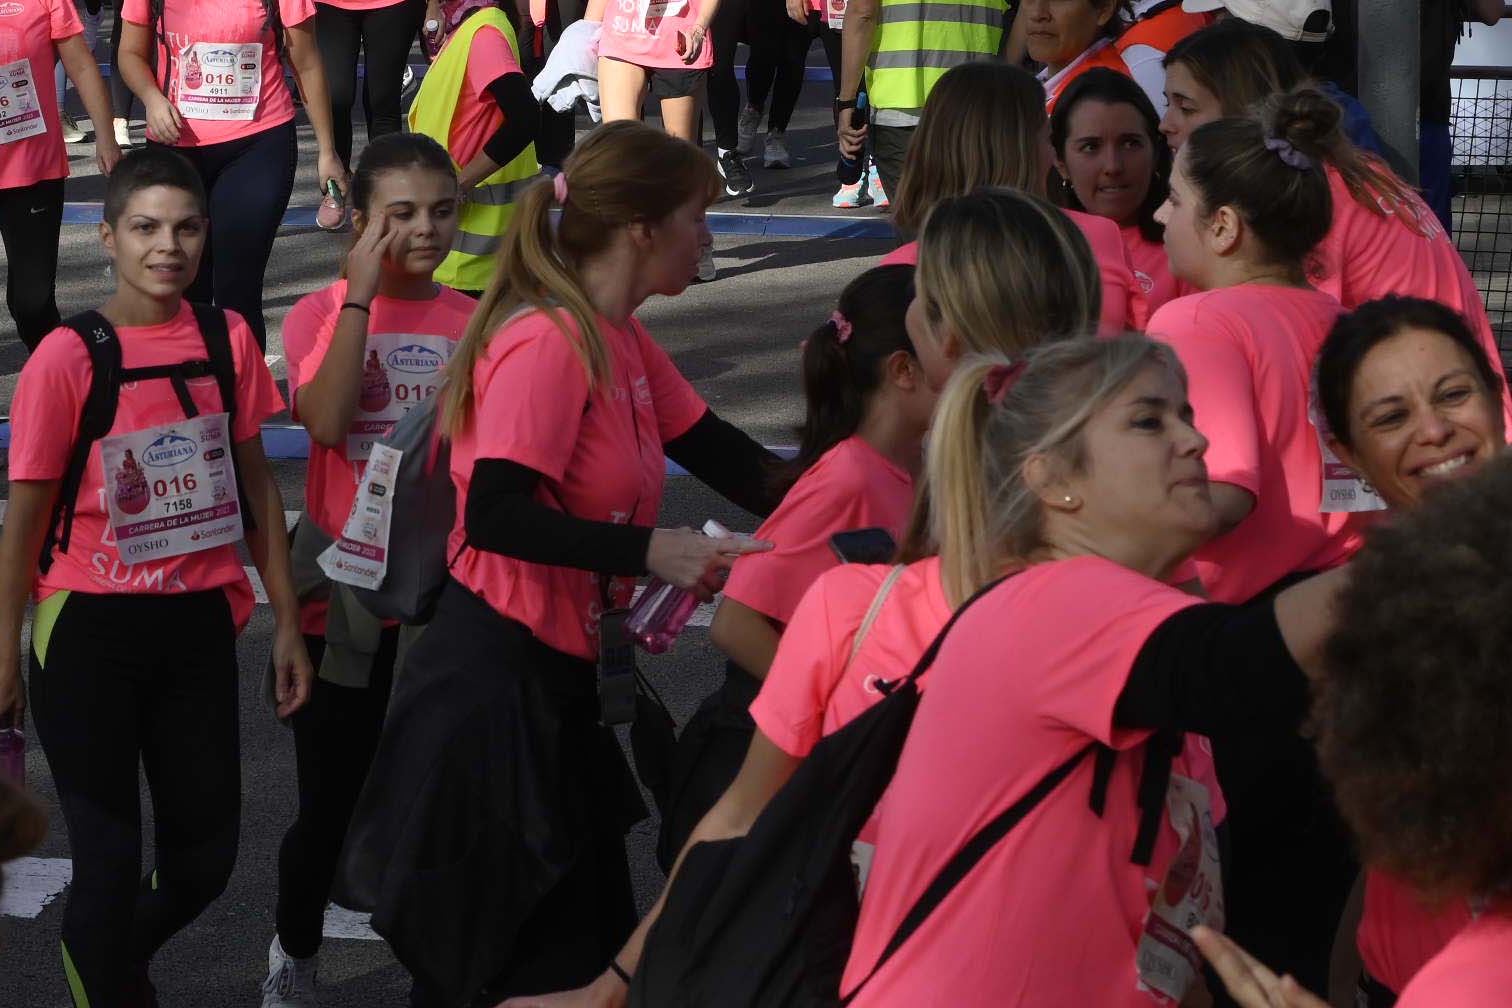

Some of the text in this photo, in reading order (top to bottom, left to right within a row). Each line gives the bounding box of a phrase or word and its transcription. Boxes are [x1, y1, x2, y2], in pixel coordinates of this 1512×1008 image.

[206, 73, 234, 84] 016
[147, 445, 193, 463] ASTURIANA
[153, 473, 197, 497] 016
[164, 498, 193, 513] 7158
[128, 521, 165, 535] CARRERA
[166, 519, 178, 527] DE
[190, 511, 214, 522] MUJER
[128, 524, 236, 555] OYSHO Santander
[91, 552, 187, 592] SUMA
